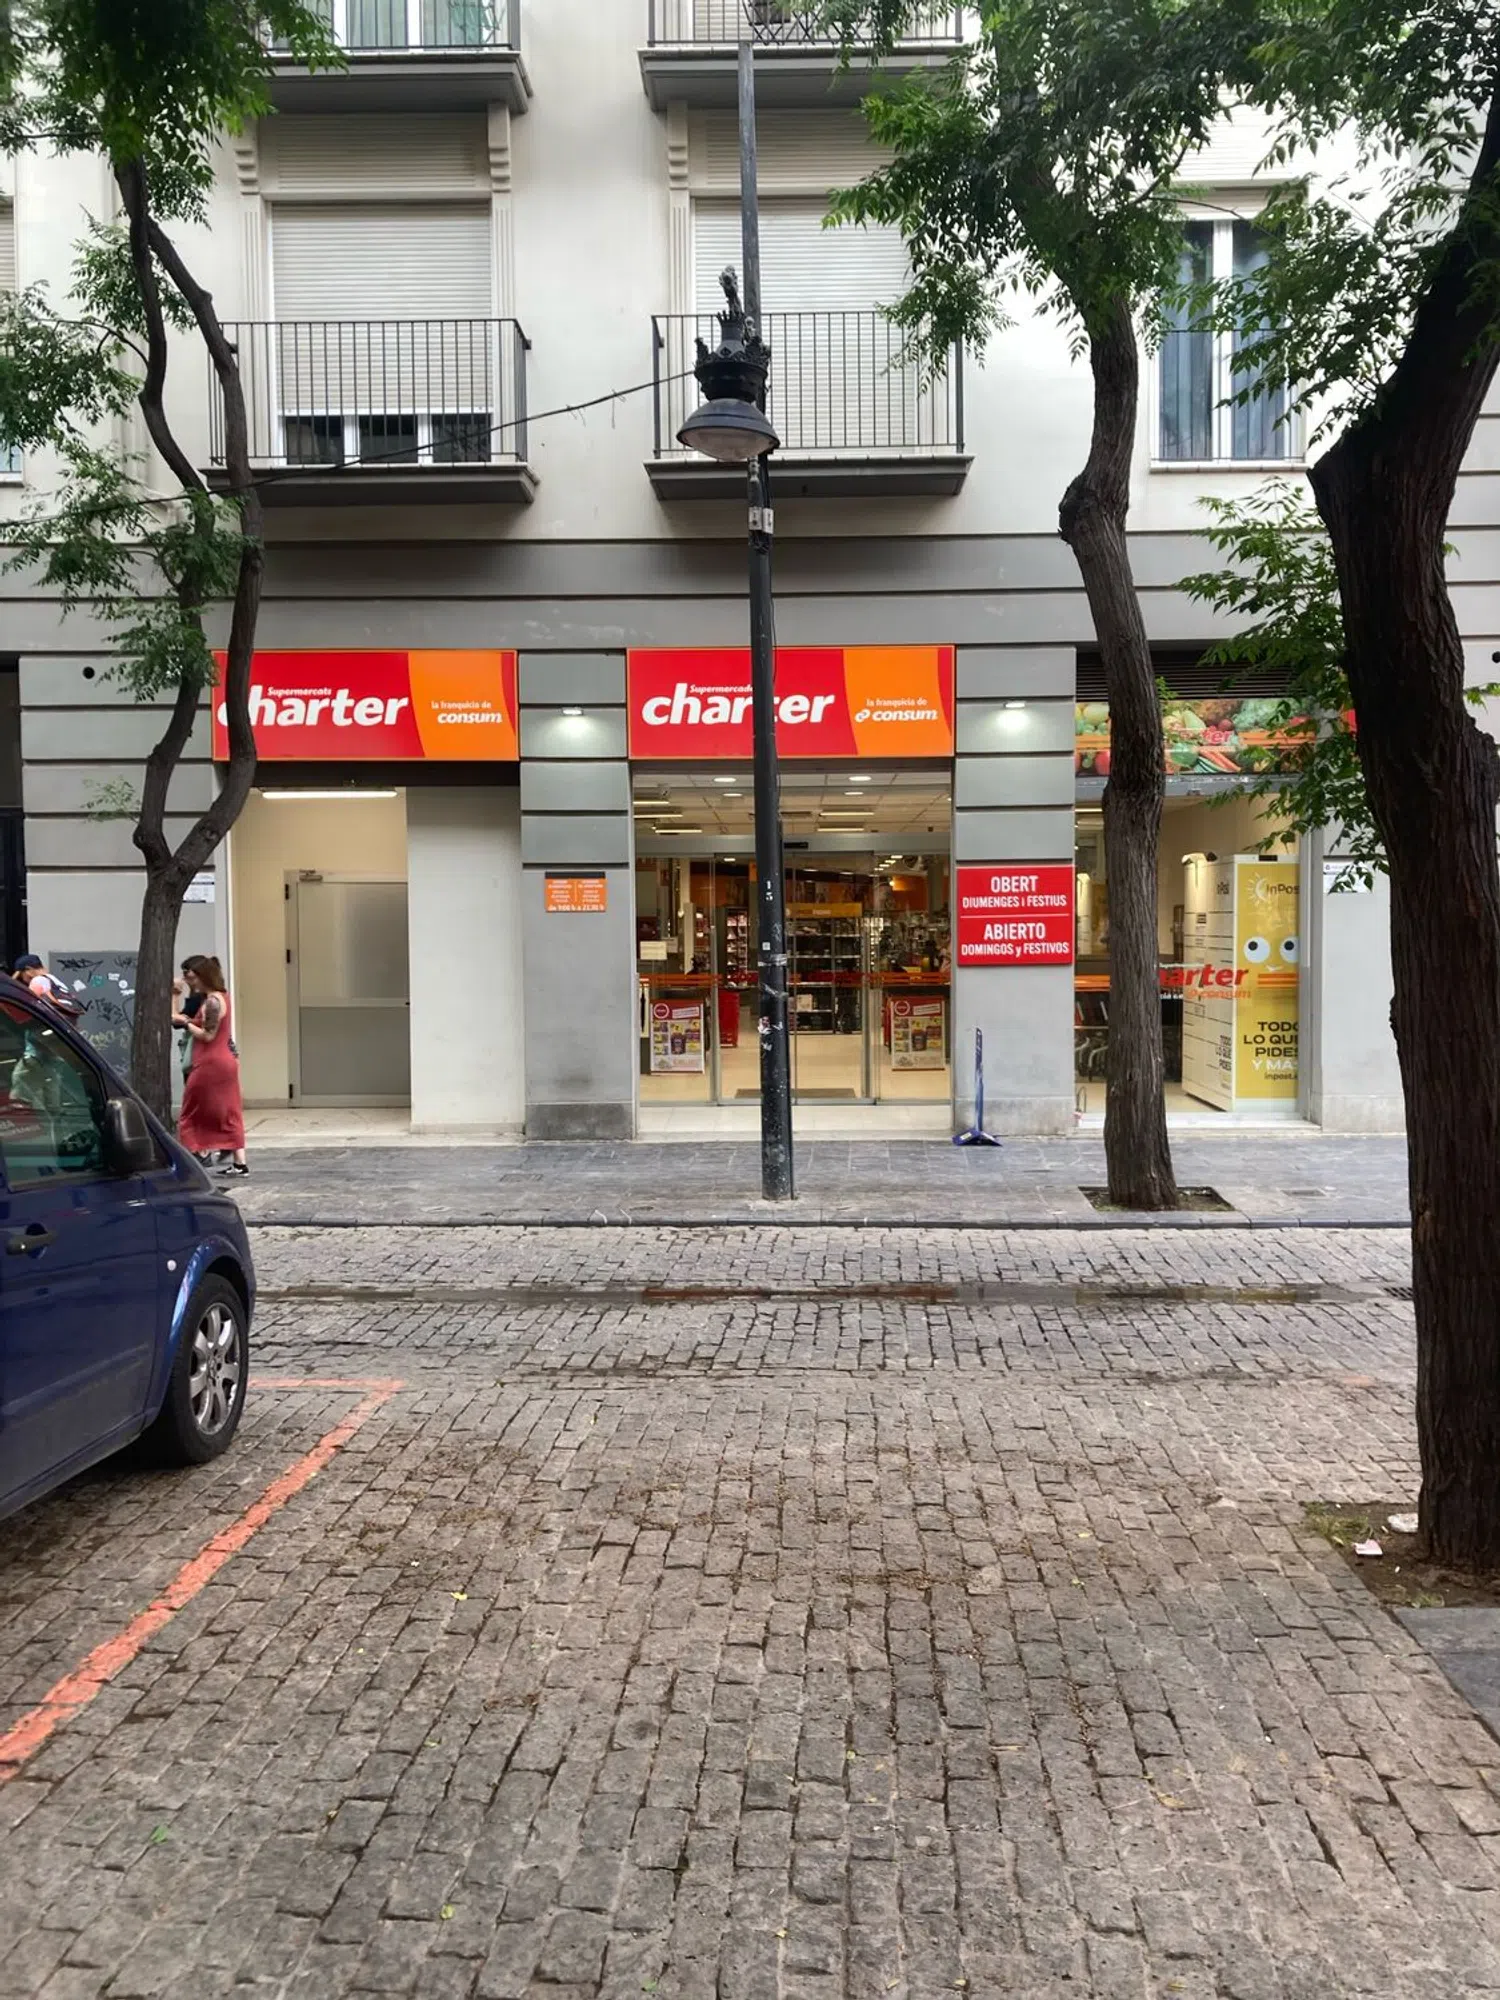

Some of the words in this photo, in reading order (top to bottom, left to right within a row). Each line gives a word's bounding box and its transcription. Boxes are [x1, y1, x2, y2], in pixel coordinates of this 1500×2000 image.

[690, 684, 753, 695] Supermercad
[431, 700, 439, 709] la
[481, 700, 492, 709] de
[641, 683, 835, 725] charer
[917, 697, 928, 706] de
[437, 712, 502, 724] consum
[872, 709, 938, 721] consum
[991, 875, 1038, 893] OBERT
[1266, 883, 1300, 895] InPos
[962, 896, 1020, 908] DIUMENGES
[1026, 895, 1067, 907] FESTIUS
[984, 922, 1046, 940] ABIERTO
[961, 943, 1014, 956] DOMINGOS
[1015, 945, 1021, 958] y
[1023, 942, 1070, 954] FESTIVOS
[1243, 1034, 1265, 1045] LO
[1251, 1059, 1262, 1070] Y
